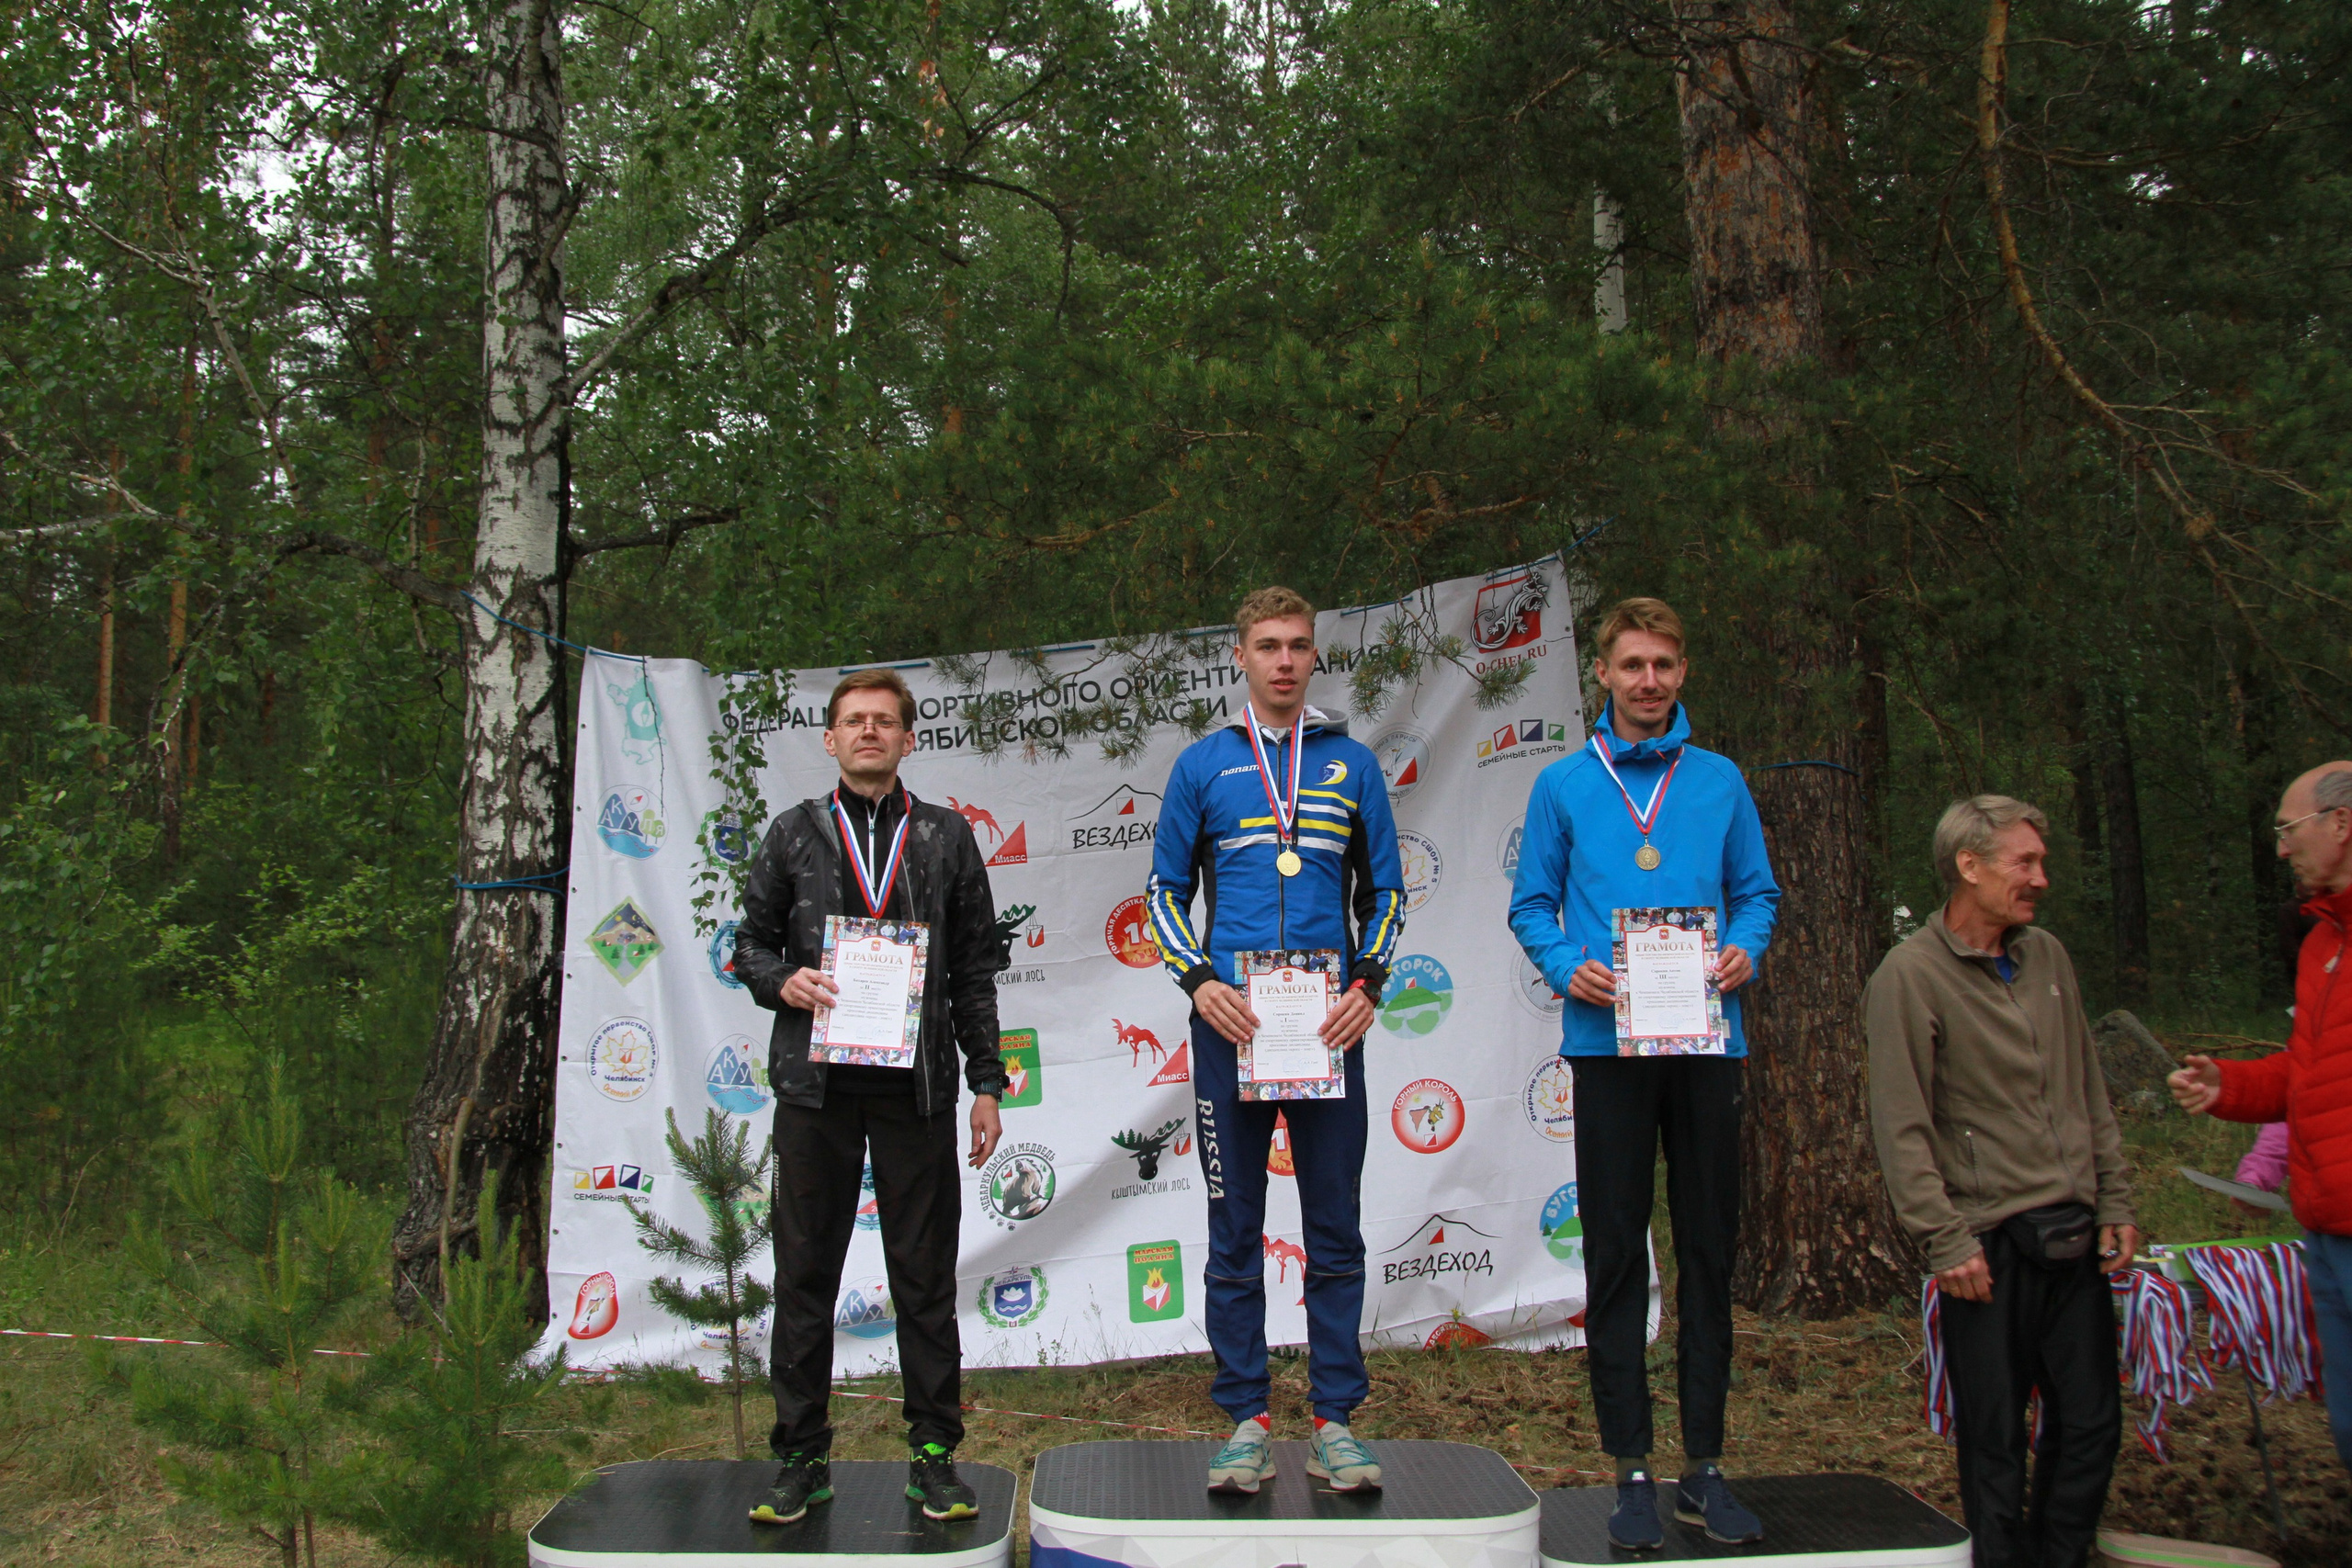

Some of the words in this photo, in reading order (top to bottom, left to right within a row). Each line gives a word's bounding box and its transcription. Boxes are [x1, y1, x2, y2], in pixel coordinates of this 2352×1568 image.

[722, 706, 827, 735] ФЕДЕРАЦ
[913, 681, 1101, 721] ОРТИВНОГО
[1477, 750, 1527, 769] СЕМЕЙНЫЕ
[1529, 744, 1566, 756] СТАРТЫ
[1220, 764, 1260, 777] nonam
[1072, 821, 1158, 851] ВЕЗДЕХ
[995, 854, 1026, 863] Миасс
[1106, 919, 1120, 954] ГОРЯЧАЯ
[1113, 897, 1145, 919] ДЕСЯТКА
[1634, 942, 1695, 953] ГРАМОТА
[844, 951, 904, 965] ГРАМОТА
[1258, 984, 1318, 995] ГРАМОТА
[999, 1033, 1031, 1043] АЙСКАЯ
[999, 1042, 1031, 1051] ОЛЯНА
[1157, 1072, 1188, 1083] Миасс
[1394, 1080, 1423, 1110] ГОРНЫЙ
[1424, 1079, 1458, 1102] КОРОЛЬ
[1544, 1114, 1572, 1124] Челяби
[1197, 1097, 1225, 1200] RUSSIA
[979, 1144, 1016, 1212] ЧЕБАРКУЛЬСКИЙ
[1018, 1142, 1056, 1162] МЕДВЕДЬ
[573, 1192, 622, 1202] СЕМЕЙНЫЕ
[625, 1195, 650, 1203] ТАРТЫ
[1111, 1179, 1168, 1200] КЫШТЫМСКИЙ
[1170, 1178, 1191, 1191] ЛОСЬ
[1546, 1185, 1577, 1219] БУГО
[1383, 1249, 1493, 1284] ВЕЗДЕХОД
[838, 1295, 893, 1326] АКУ
[703, 1331, 750, 1340] Челябск
